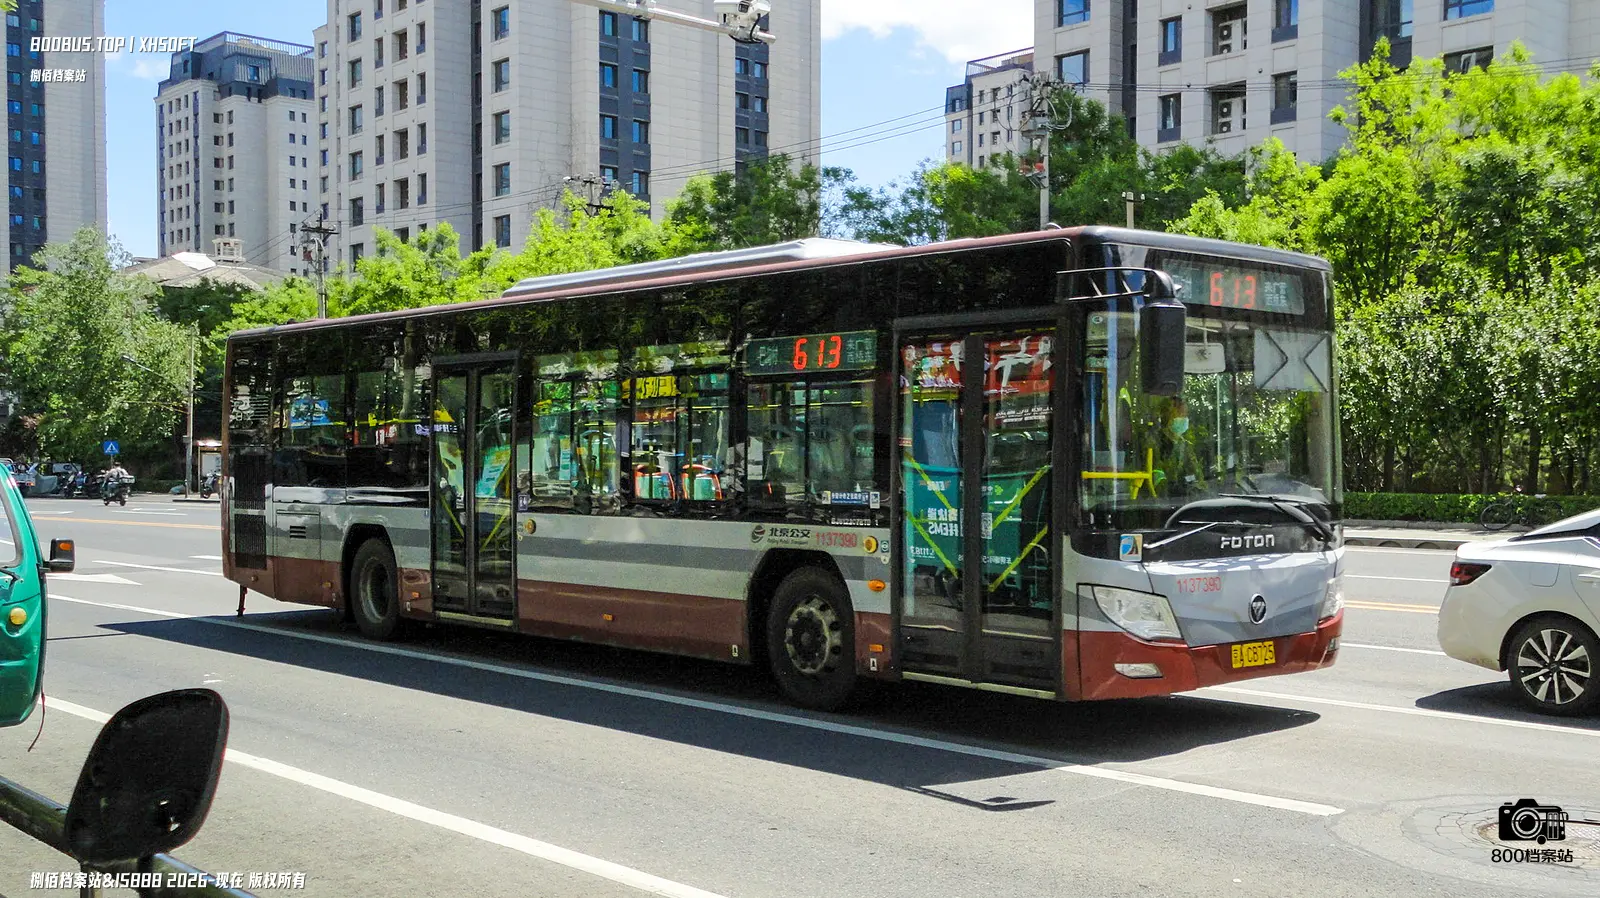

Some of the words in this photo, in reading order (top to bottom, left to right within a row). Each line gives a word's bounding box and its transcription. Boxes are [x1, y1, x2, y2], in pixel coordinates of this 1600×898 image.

[1210, 272, 1257, 309] 613
[793, 336, 842, 370] 613
[815, 532, 858, 548] 1137390
[1220, 534, 1275, 549] FOTON
[1176, 576, 1222, 593] 1137390
